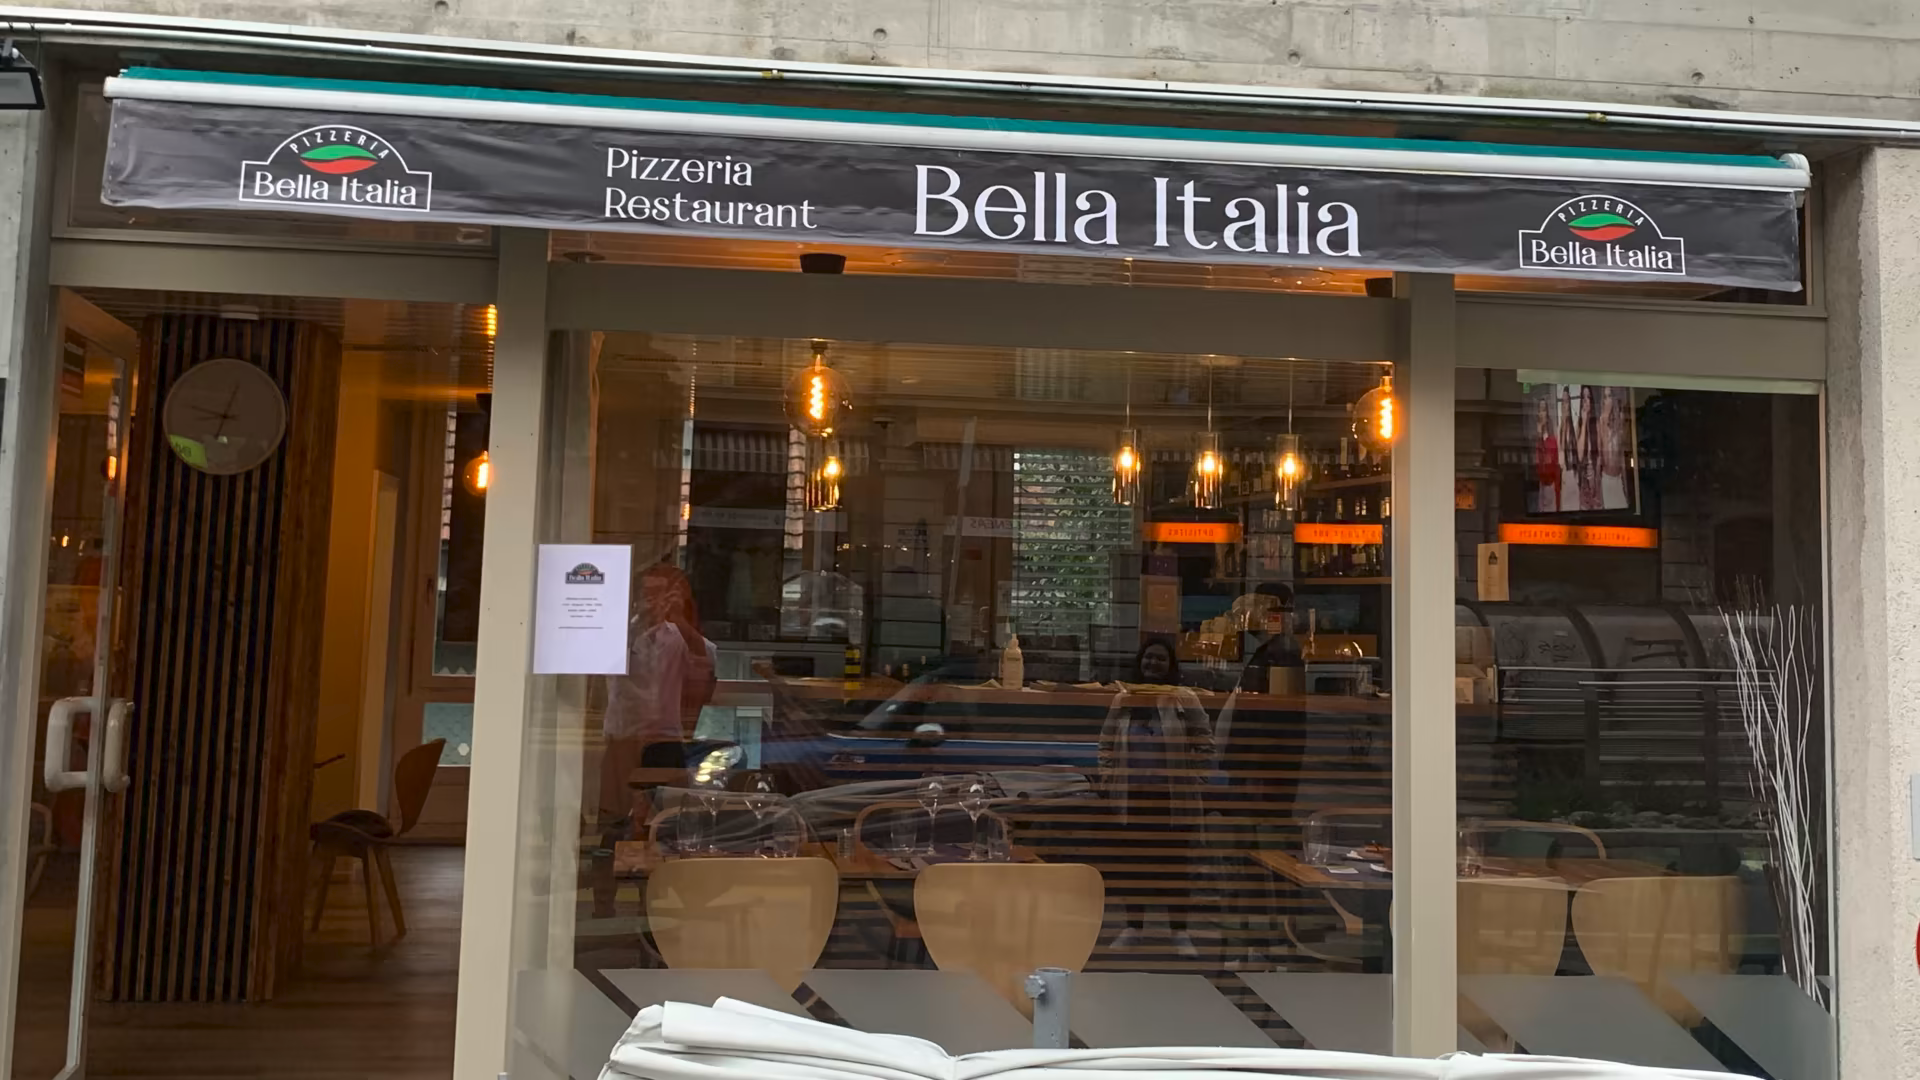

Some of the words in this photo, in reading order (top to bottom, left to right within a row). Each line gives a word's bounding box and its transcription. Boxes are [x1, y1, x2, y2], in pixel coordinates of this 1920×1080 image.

[289, 130, 390, 159] PIZZERIA
[606, 147, 753, 187] Pizzeria
[253, 170, 329, 200] Bella
[340, 175, 417, 206] Italia
[604, 186, 818, 229] Restaurant
[913, 163, 1120, 246] Bella
[1153, 177, 1362, 257] Italia
[1557, 199, 1645, 226] PIZZERIA
[1531, 239, 1597, 266] Bella
[1606, 243, 1673, 270] Italia
